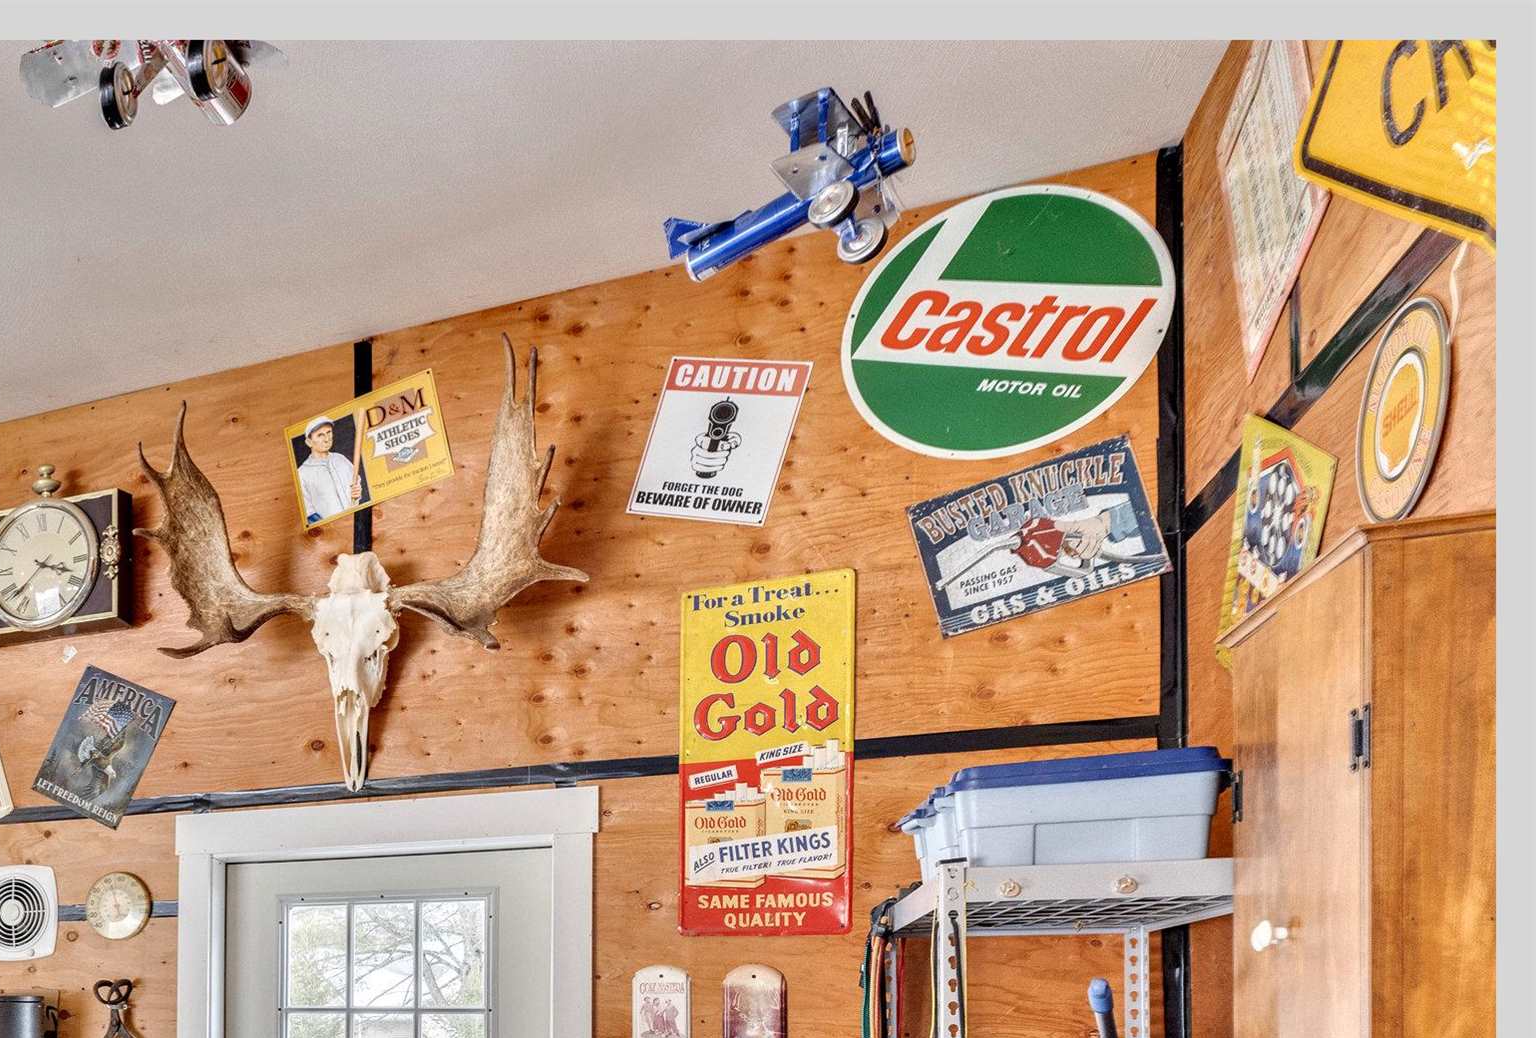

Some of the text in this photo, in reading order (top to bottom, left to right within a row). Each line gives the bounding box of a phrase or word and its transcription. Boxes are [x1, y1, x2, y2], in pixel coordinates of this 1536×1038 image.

[880, 290, 1158, 363] Castrol
[675, 364, 797, 392] CAUTION
[976, 378, 1082, 399] MOTOR OIL
[366, 387, 428, 429] D&M
[376, 415, 427, 444] ATHLETIC
[384, 430, 421, 451] SHOES
[662, 481, 743, 497] FORGET THE DOG
[917, 452, 1127, 545] BUSTED KNUCKLE
[635, 490, 763, 515] BEWARE OF OWNER
[967, 484, 1090, 542] GARAGE
[960, 564, 1018, 589] PASSING GAS
[964, 575, 1014, 597] SINCE 1957
[691, 594, 728, 611] For
[731, 594, 745, 605] a
[970, 563, 1136, 624] GAS & OILS
[724, 605, 806, 628] Smoke
[710, 629, 822, 684] Old
[73, 677, 162, 740] AMERICA
[694, 685, 840, 742] Gold
[760, 743, 804, 761] KING SIZE
[694, 769, 733, 786] REGULAR
[36, 777, 118, 824] LET FREEDOM REIGN
[770, 787, 827, 802] Old Gold
[694, 815, 747, 830] Old Gold
[693, 831, 831, 871] ALSO FILTER KINGS
[720, 852, 833, 874] TRUE FILTER! TRUE FLAVOR!
[698, 891, 834, 909] SAME FAMOUS
[723, 911, 806, 930] QUALITY
